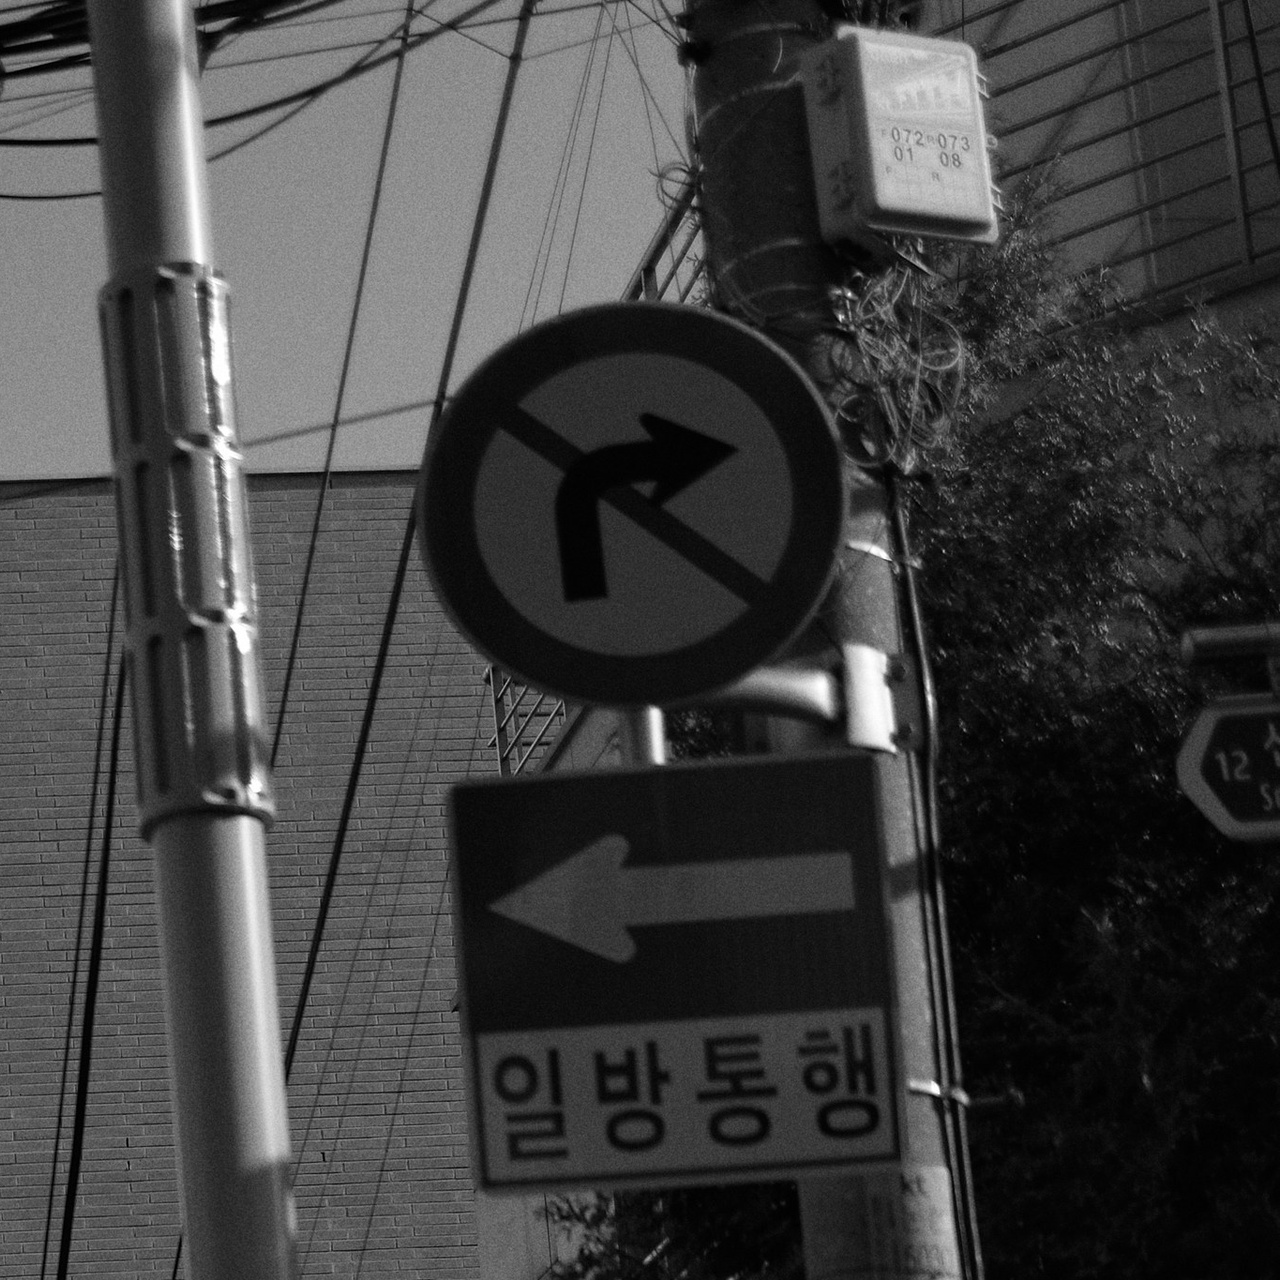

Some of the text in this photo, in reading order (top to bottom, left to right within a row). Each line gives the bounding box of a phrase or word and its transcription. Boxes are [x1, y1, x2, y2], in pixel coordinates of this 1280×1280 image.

[892, 127, 924, 147] 072
[938, 133, 970, 151] 073
[894, 146, 962, 168] 01 08
[1215, 750, 1250, 781] 12
[494, 1023, 880, 1161] 일방통행
